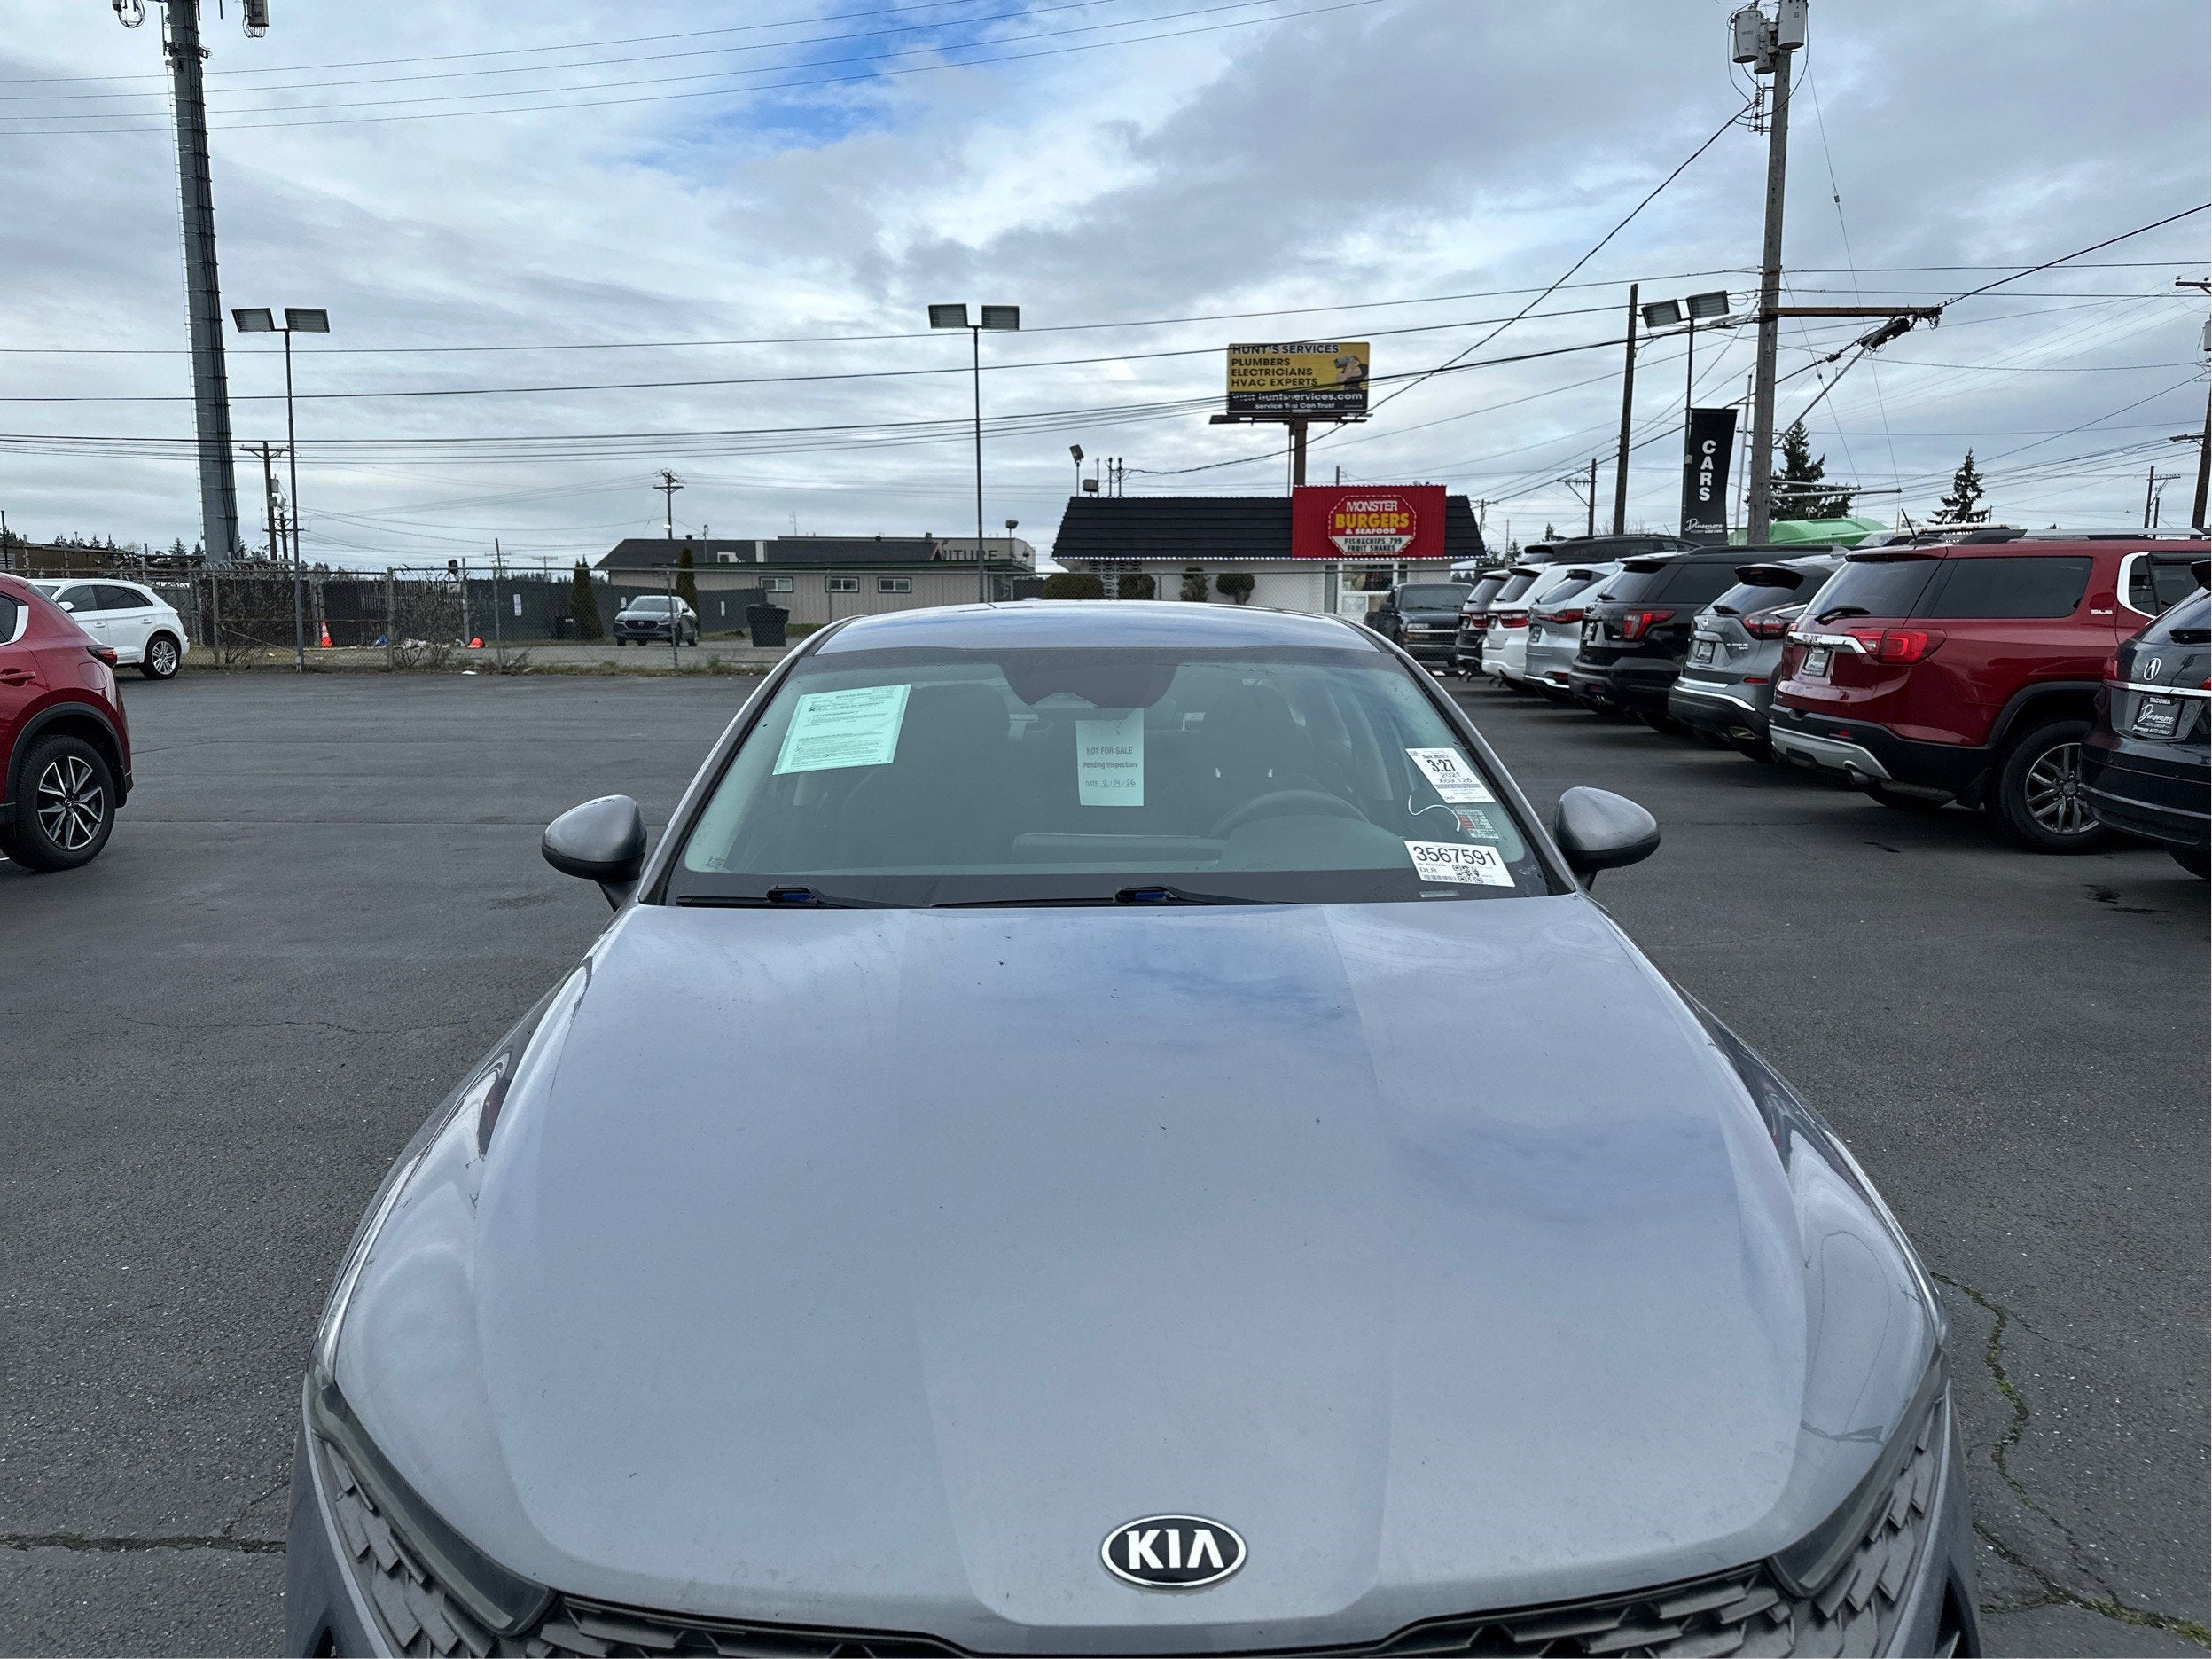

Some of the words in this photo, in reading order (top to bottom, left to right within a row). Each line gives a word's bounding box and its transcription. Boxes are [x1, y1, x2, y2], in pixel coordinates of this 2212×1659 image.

[1231, 345, 1279, 354] HUNT'S
[1282, 344, 1339, 354] SERVICES
[1231, 357, 1291, 366] PLUMBERS
[1231, 378, 1268, 387] HVAC
[1270, 378, 1317, 387] EXPERTS
[1698, 440, 1716, 502] CARS
[1346, 500, 1398, 512] MONSTER
[1335, 513, 1409, 528] BURGERS
[1426, 759, 1457, 772] 3:27
[1413, 846, 1497, 865] 3567591
[1126, 1529, 1224, 1569] KIA
